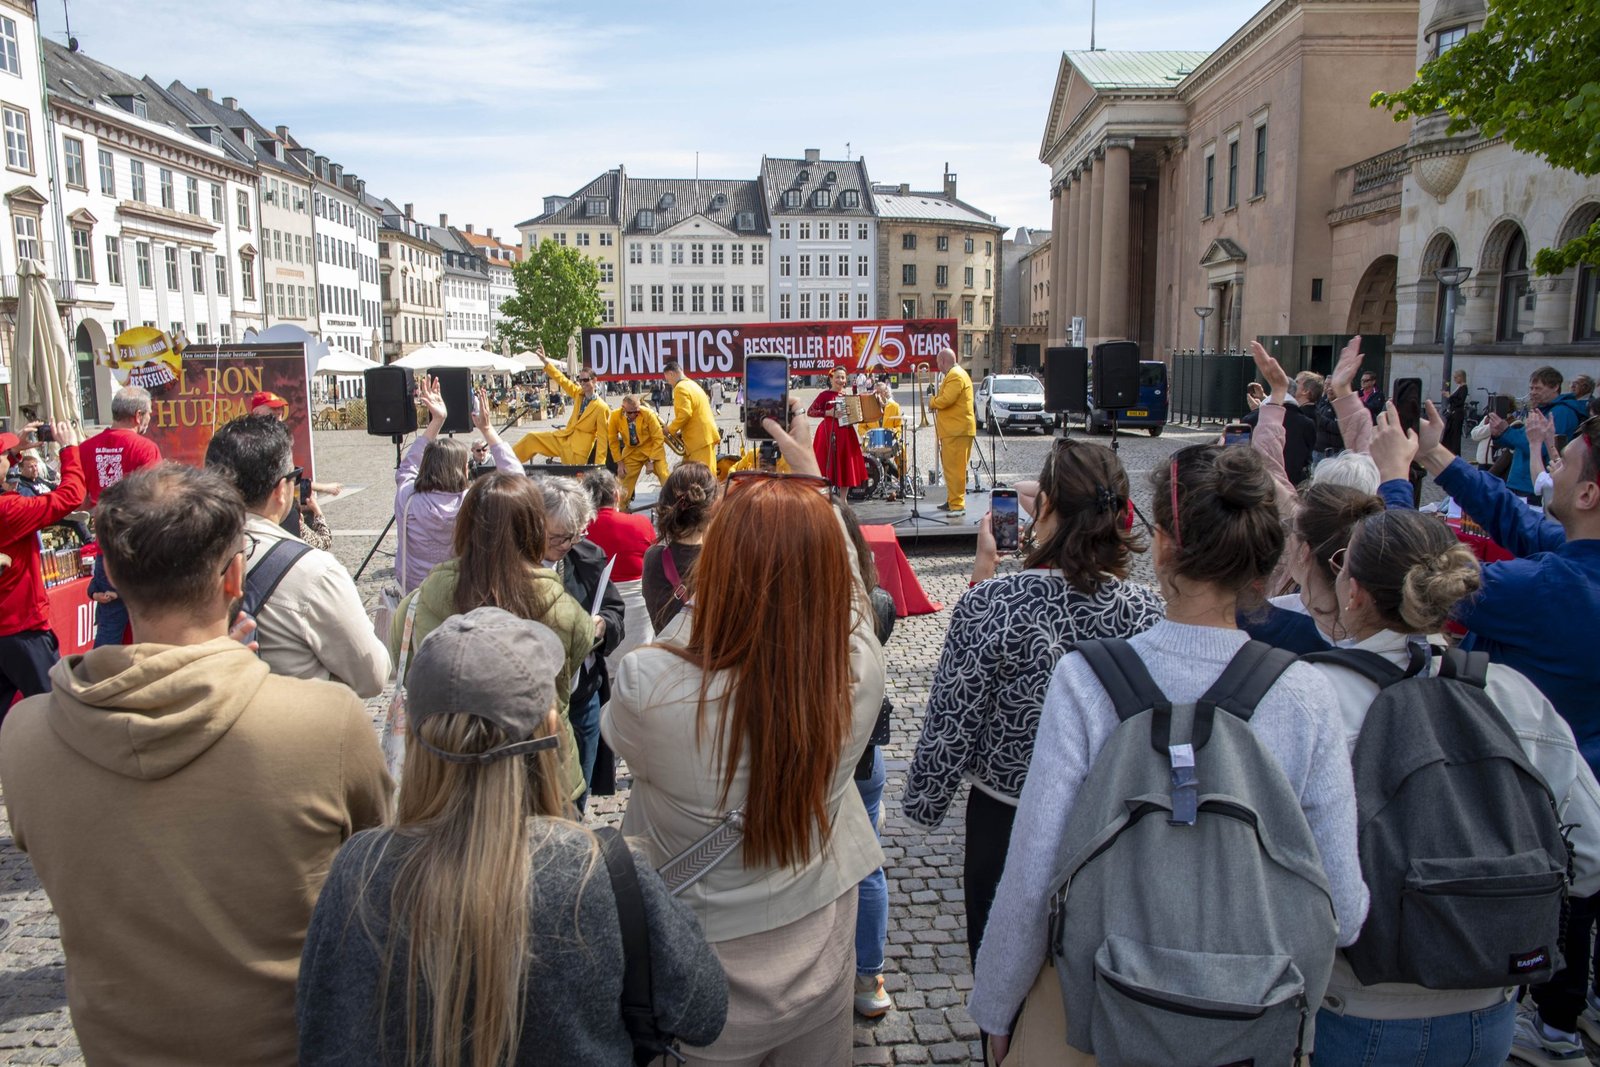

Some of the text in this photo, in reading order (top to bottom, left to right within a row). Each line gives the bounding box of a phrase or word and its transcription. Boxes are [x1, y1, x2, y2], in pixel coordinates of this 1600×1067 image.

[119, 348, 128, 359] 75
[194, 351, 232, 359] internatonale
[744, 325, 951, 369] BESTSELLER FOR 75 YEARS
[793, 359, 835, 369] 9 MAY 2025
[130, 367, 175, 388] BESTSELLER
[178, 366, 264, 396] L. RON
[155, 396, 290, 428] HUBBA
